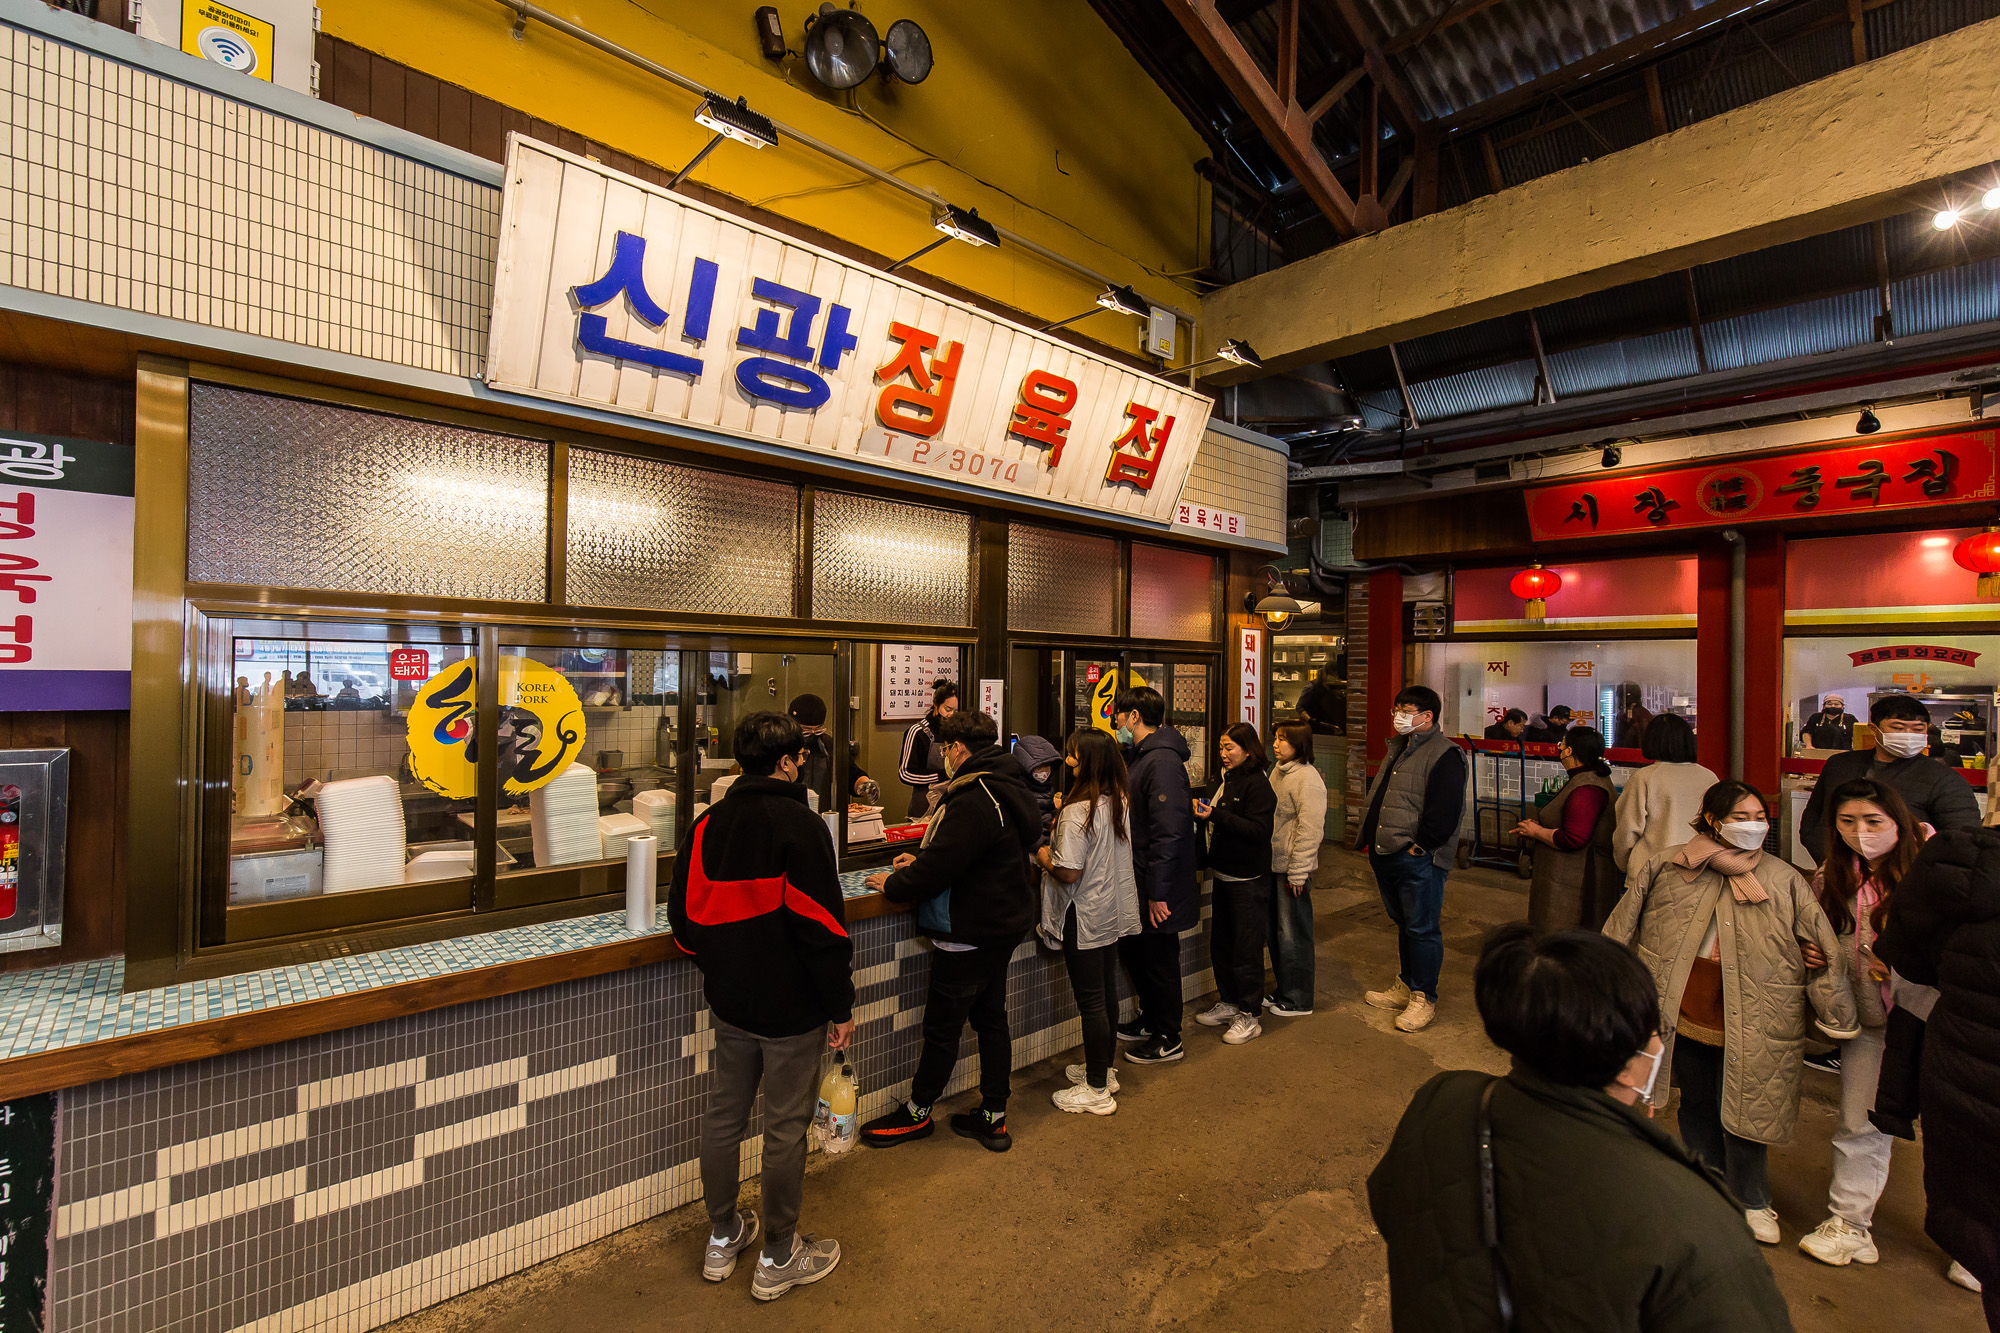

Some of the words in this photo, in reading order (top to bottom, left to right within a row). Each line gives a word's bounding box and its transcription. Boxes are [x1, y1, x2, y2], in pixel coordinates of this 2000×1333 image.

[1180, 505, 1238, 534] 정육식당
[395, 653, 426, 664] 우리
[394, 665, 426, 676] 돼지
[1244, 634, 1256, 725] 돼지고기
